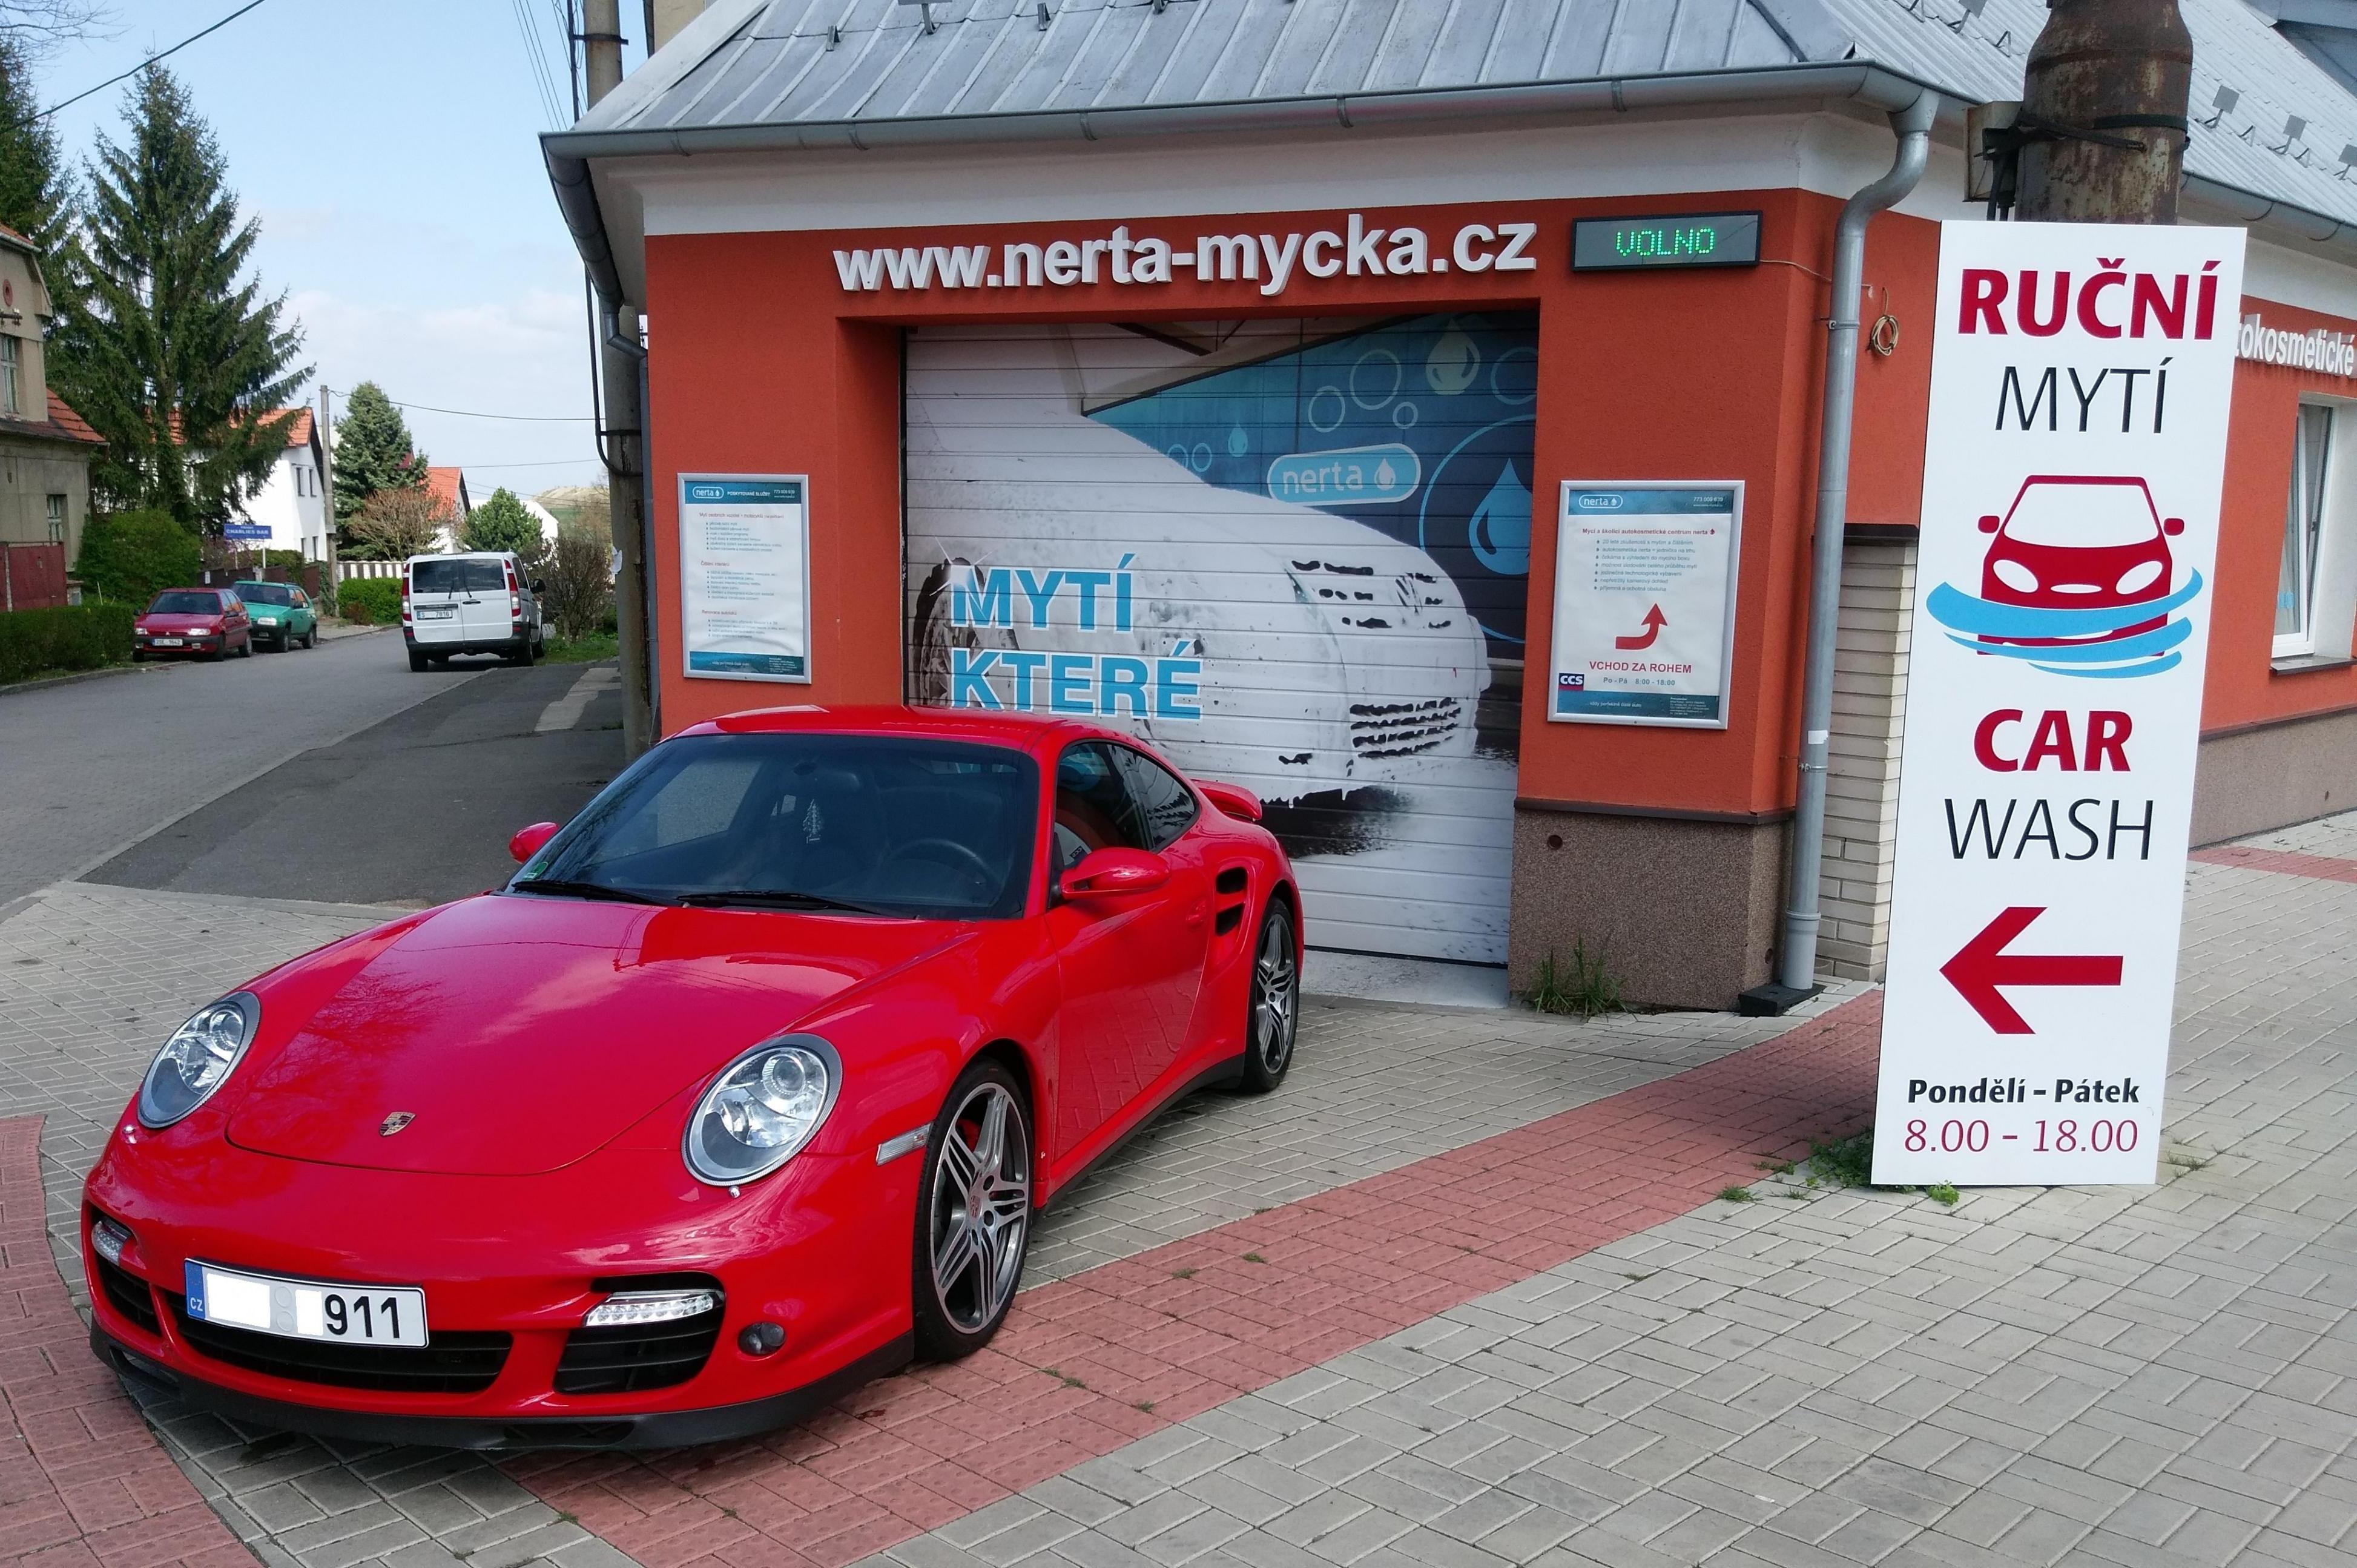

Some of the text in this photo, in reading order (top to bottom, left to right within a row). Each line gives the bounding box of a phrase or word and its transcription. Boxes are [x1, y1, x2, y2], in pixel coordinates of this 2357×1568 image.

[832, 214, 1537, 295] www.nerta-mycka.cz
[1615, 227, 1715, 257] VOLNO
[1958, 257, 2221, 340] RUČNÍ
[1995, 357, 2174, 433] MYTÍ
[1283, 461, 1363, 494] nerta
[1583, 496, 1609, 506] nerta
[951, 553, 1135, 634] MYTÍ
[951, 639, 1204, 720] KTERÉ
[1560, 675, 1583, 685] CCS
[1589, 661, 1692, 673] VCHOD ZA ROHEM
[1973, 708, 2133, 772] CAR
[1944, 798, 2154, 860] WASH
[1907, 1078, 2025, 1104] Pondělí
[2054, 1076, 2140, 1104] Pátek
[1904, 1119, 1990, 1153] 8.00
[2032, 1119, 2139, 1153] 18.00
[190, 1297, 204, 1312] CZ
[324, 1293, 400, 1339] 911
